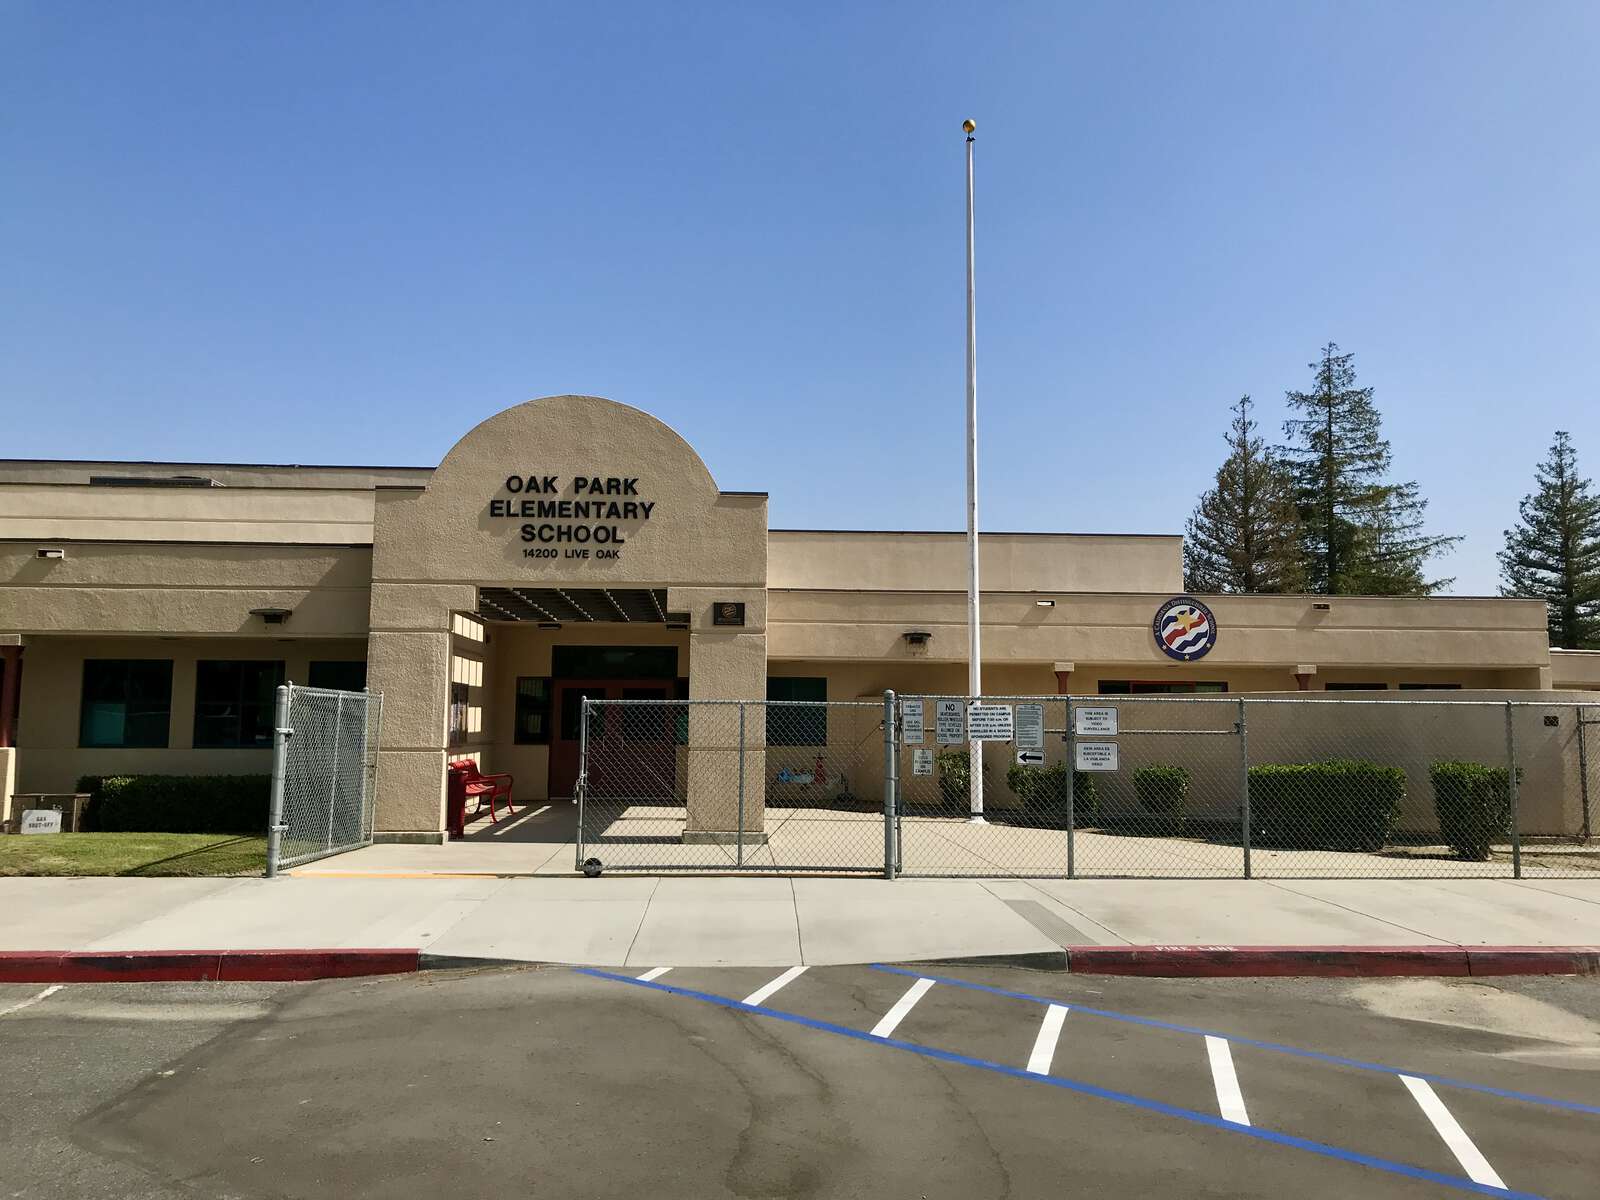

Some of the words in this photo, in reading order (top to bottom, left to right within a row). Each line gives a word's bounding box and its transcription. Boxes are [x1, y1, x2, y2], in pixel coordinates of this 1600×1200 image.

[506, 475, 558, 494] OAK
[574, 476, 639, 495] PARK
[489, 500, 656, 520] ELEMENTARY
[520, 523, 625, 544] SCHOOL
[523, 548, 558, 559] 14200
[565, 549, 590, 559] LIVE
[596, 549, 620, 560] OAK
[945, 703, 955, 711] NO
